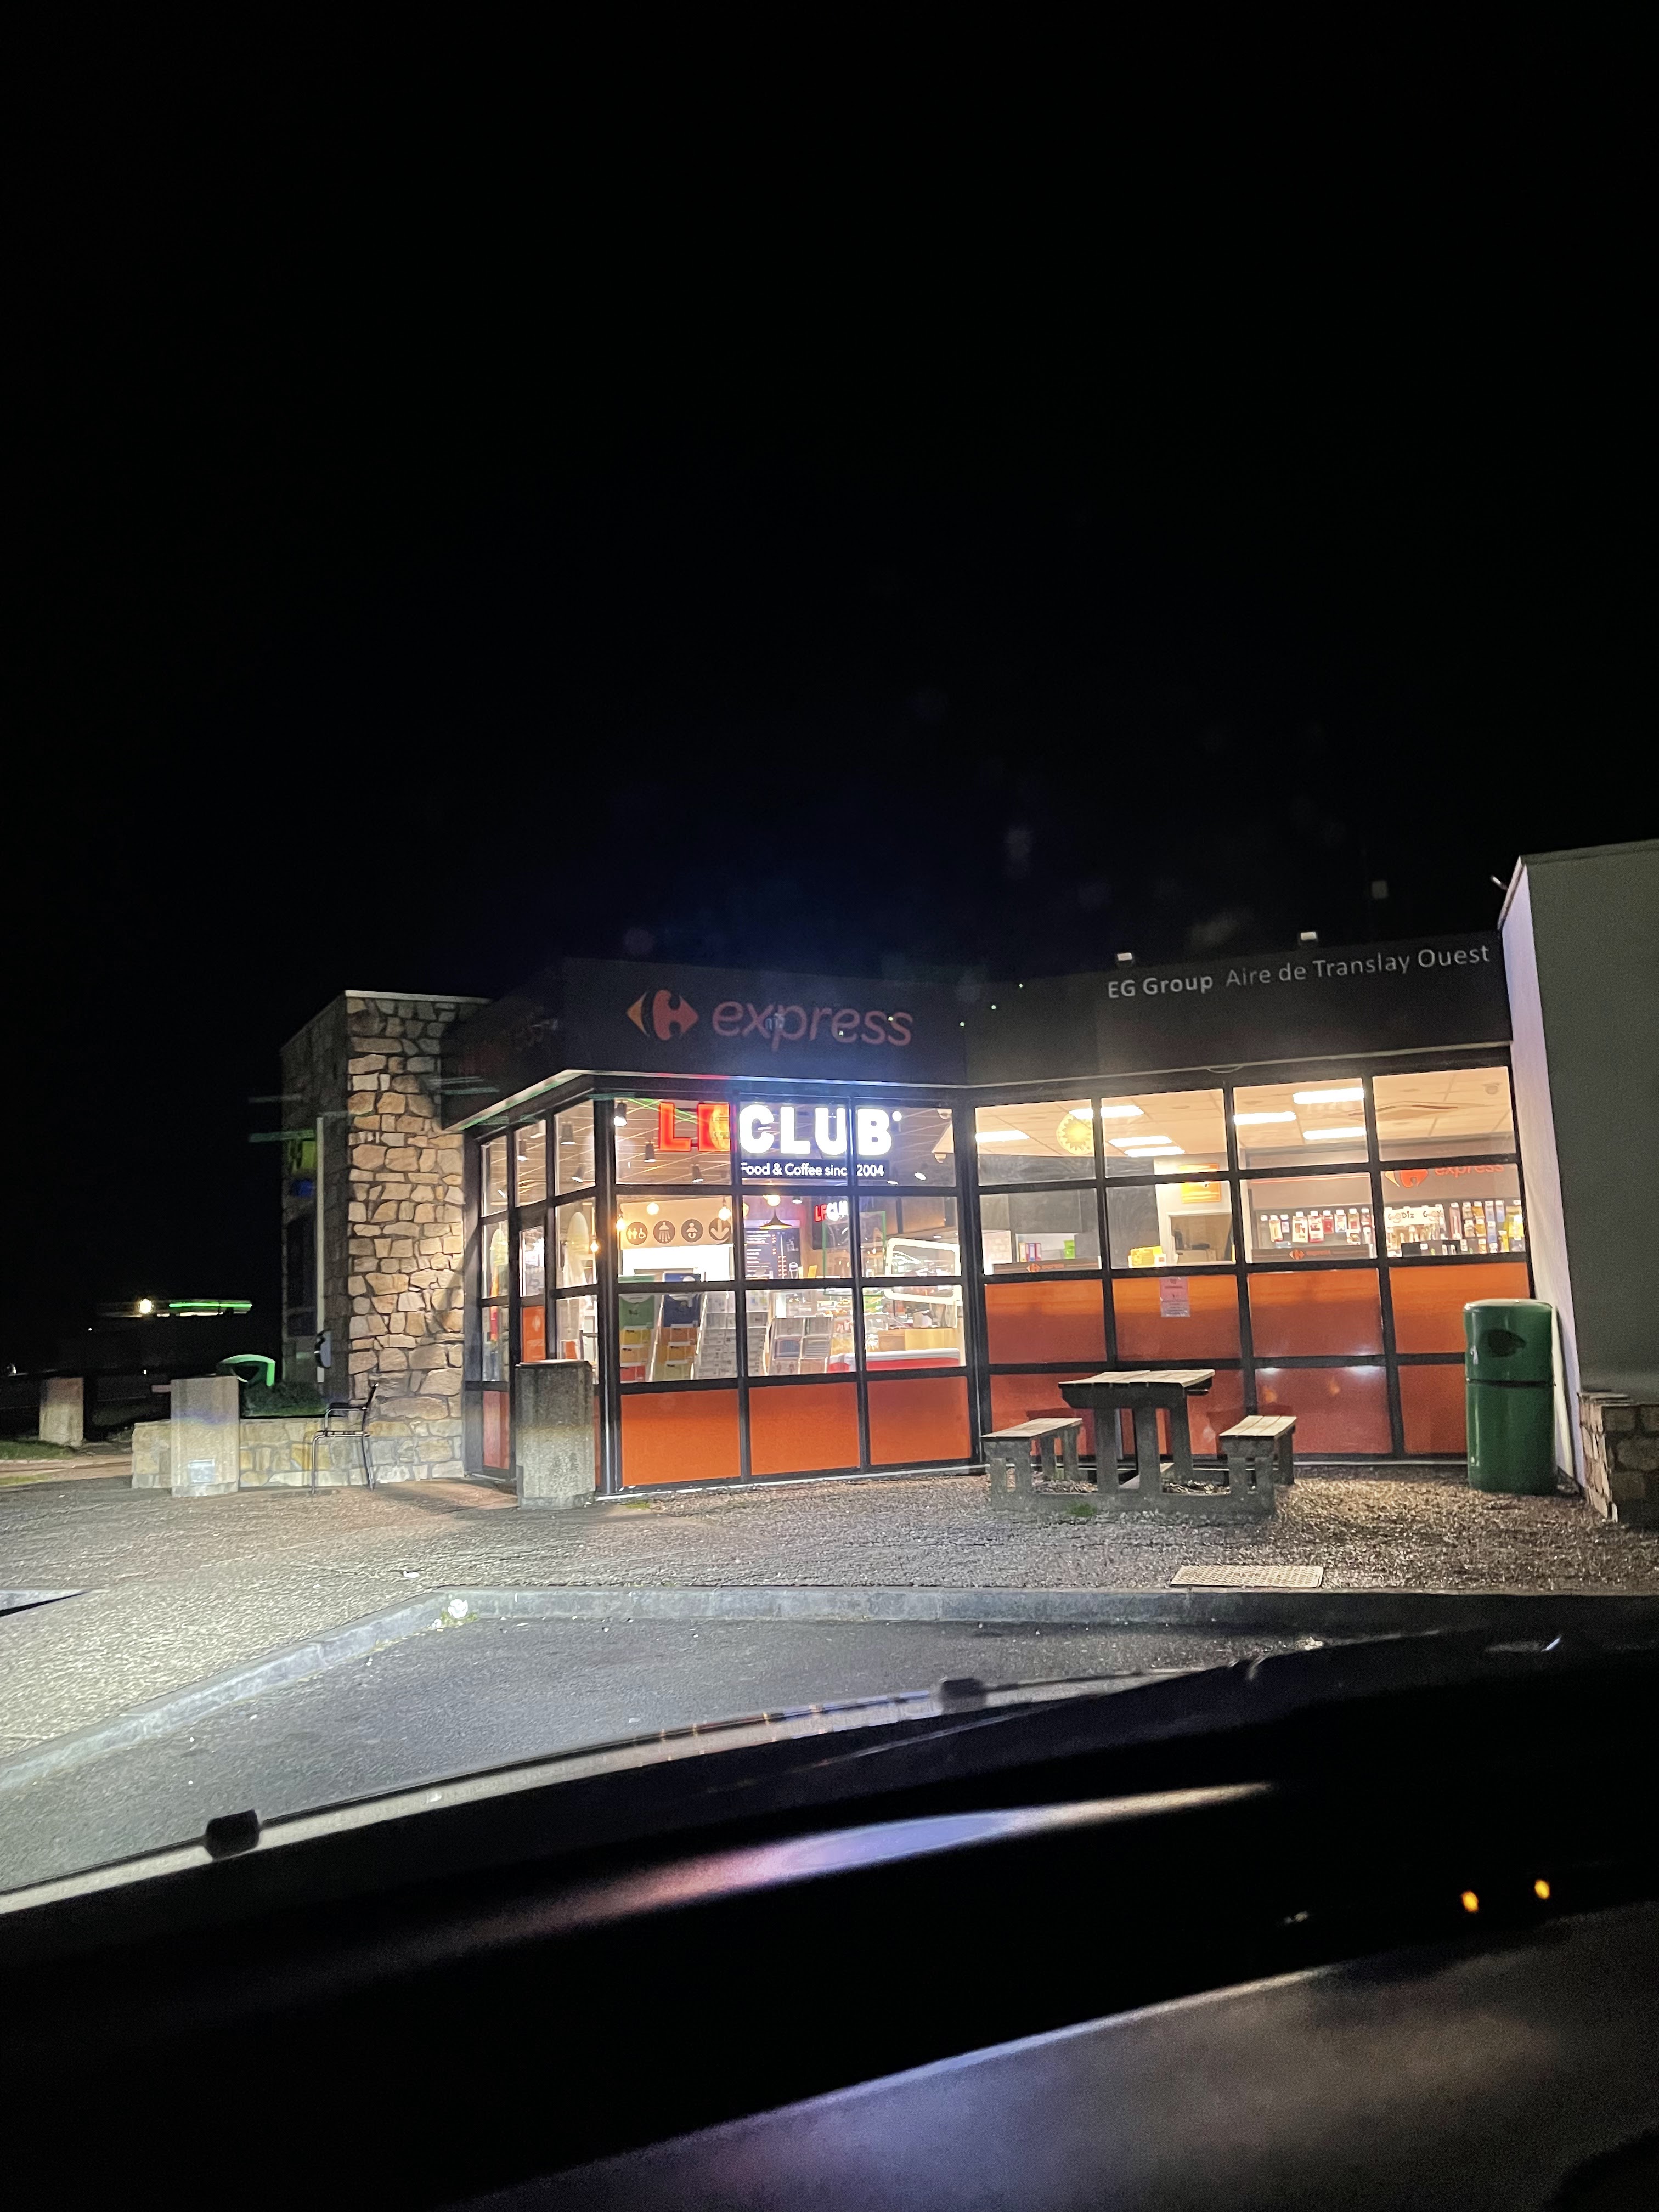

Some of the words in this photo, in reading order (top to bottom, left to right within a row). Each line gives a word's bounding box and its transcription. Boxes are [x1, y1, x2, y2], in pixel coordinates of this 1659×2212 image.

[1108, 980, 1136, 998] EG
[1142, 974, 1213, 995] Group
[1226, 967, 1271, 988] Aire
[1279, 962, 1307, 983] de
[1312, 953, 1410, 978] Translay
[1418, 944, 1491, 968] Ouest
[713, 1001, 913, 1052] express
[739, 1104, 893, 1156] CLUB
[741, 1162, 770, 1175] Food
[772, 1163, 783, 1175] &
[784, 1163, 822, 1176] Coffee
[825, 1164, 848, 1176] sinc
[856, 1164, 884, 1177] 2004
